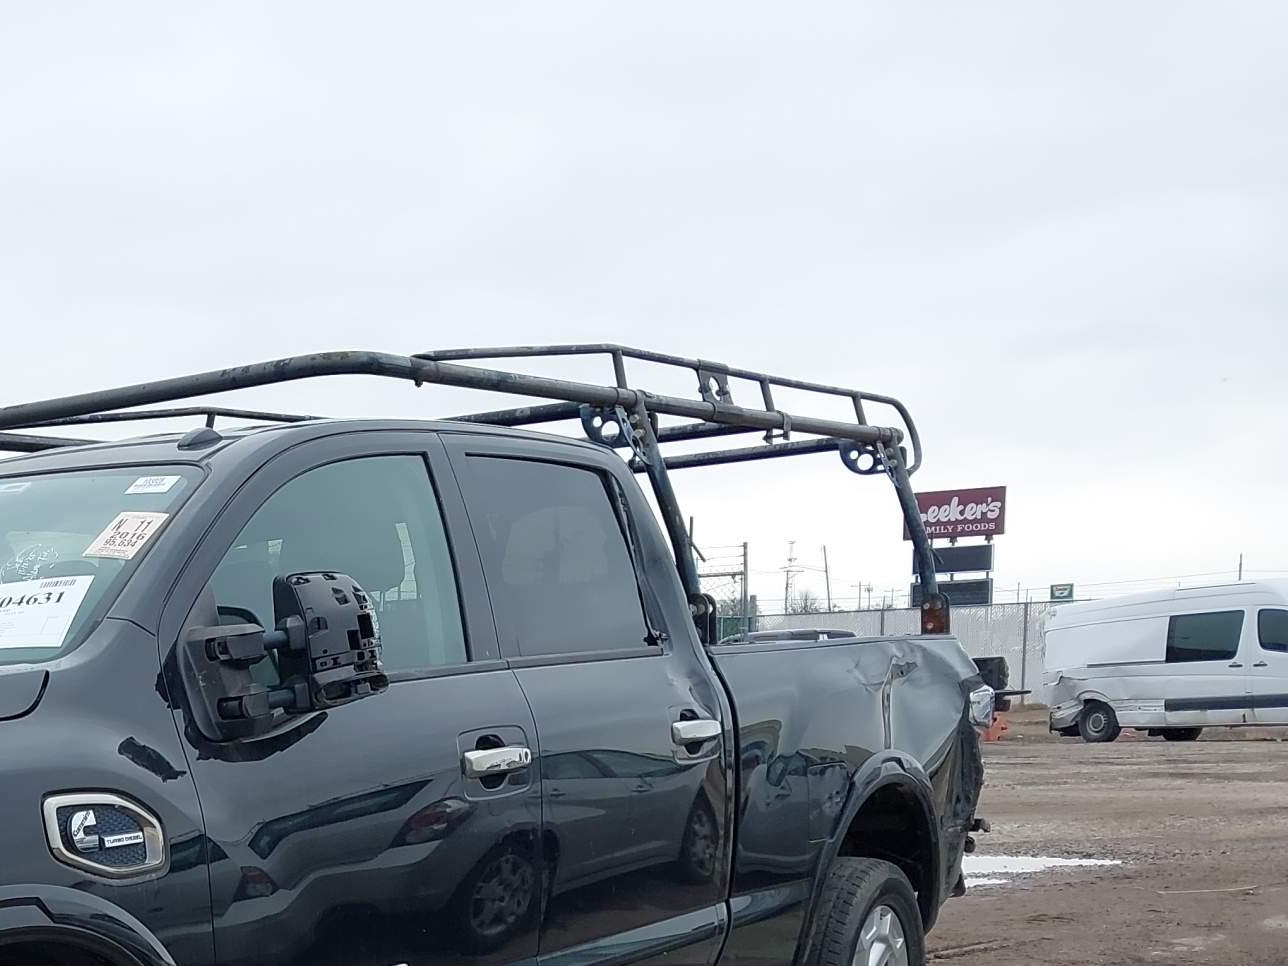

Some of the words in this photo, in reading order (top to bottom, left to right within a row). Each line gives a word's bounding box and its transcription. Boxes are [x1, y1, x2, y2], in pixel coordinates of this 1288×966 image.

[111, 518, 129, 531] N
[134, 519, 154, 533] 11
[925, 525, 954, 534] MILY
[957, 522, 996, 532] FOODS
[109, 531, 148, 541] 2016
